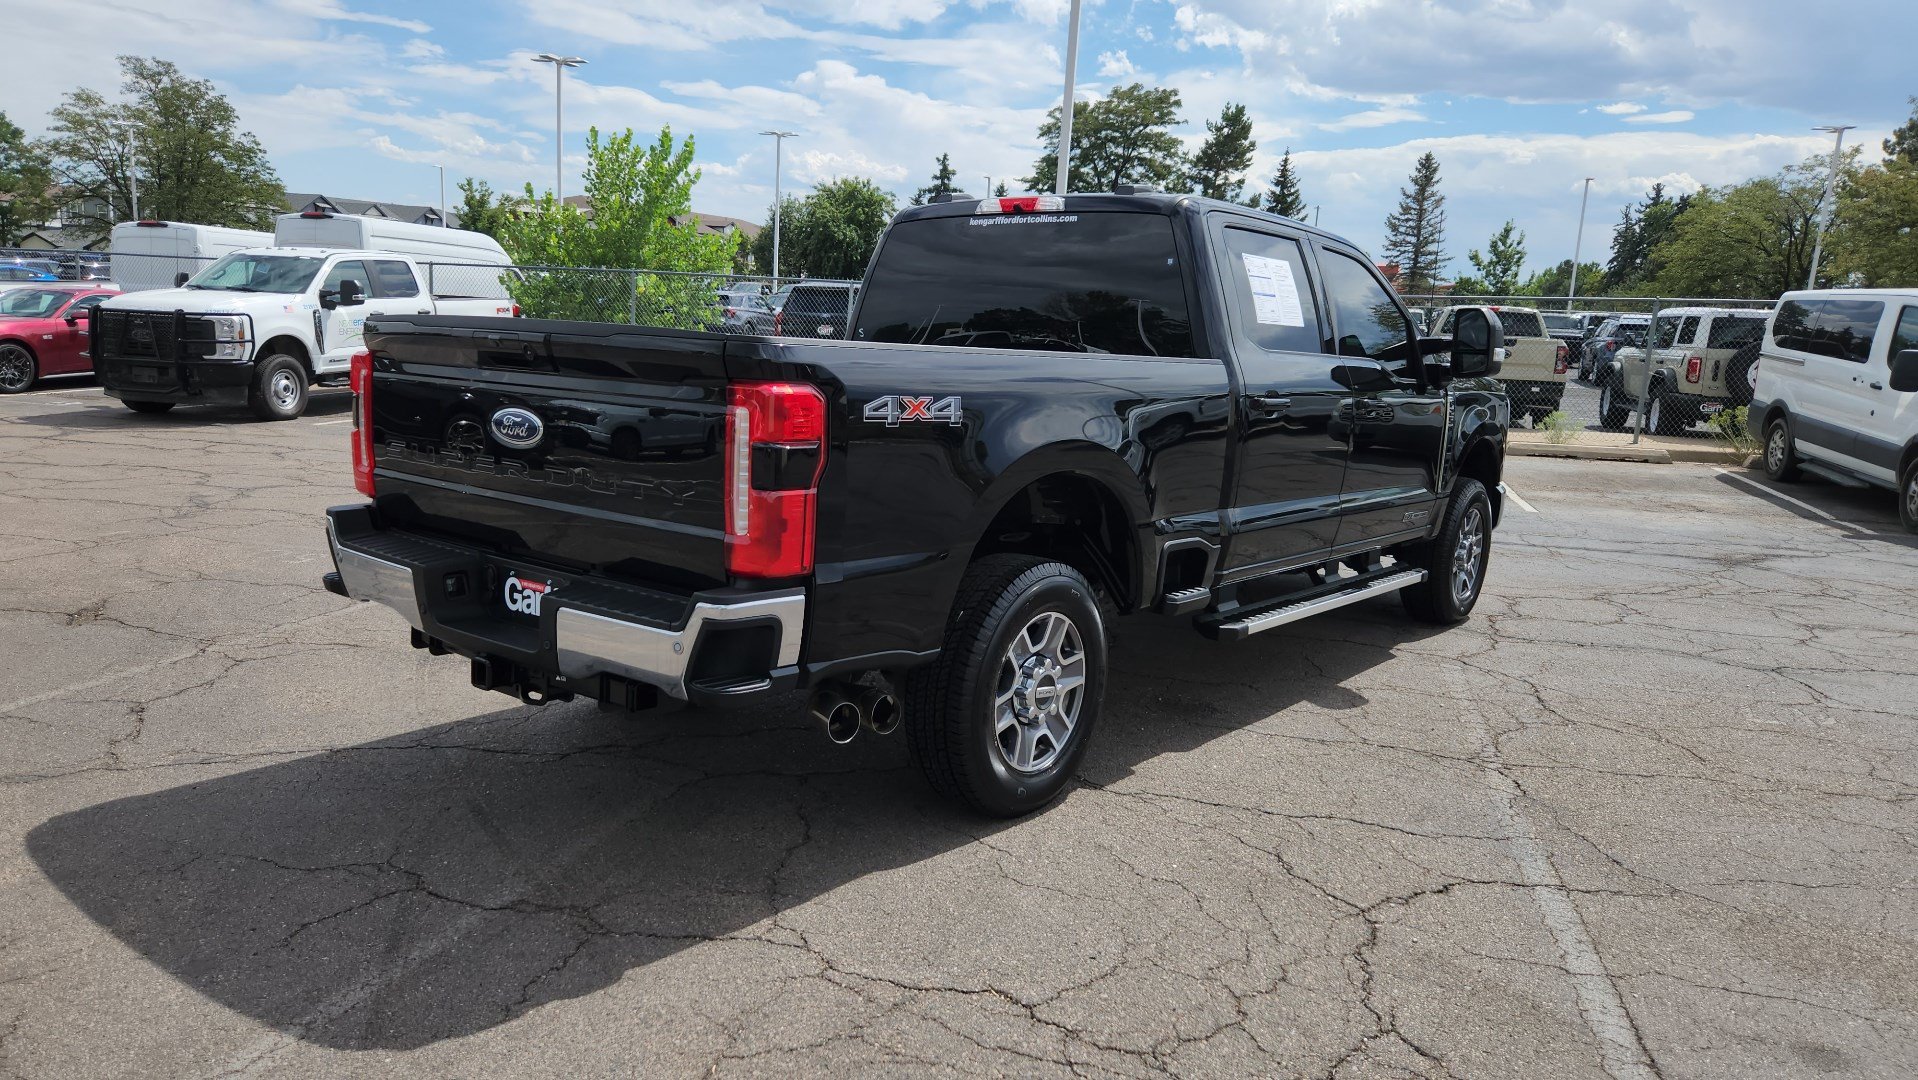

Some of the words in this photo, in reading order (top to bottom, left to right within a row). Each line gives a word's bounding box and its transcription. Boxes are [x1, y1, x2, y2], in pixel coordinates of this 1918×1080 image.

[969, 215, 1078, 227] kengarfffordfortcollins.com
[500, 415, 529, 437] Ford
[385, 439, 530, 481] SUPER
[544, 464, 696, 506] DUTY
[504, 576, 552, 617] Gar
